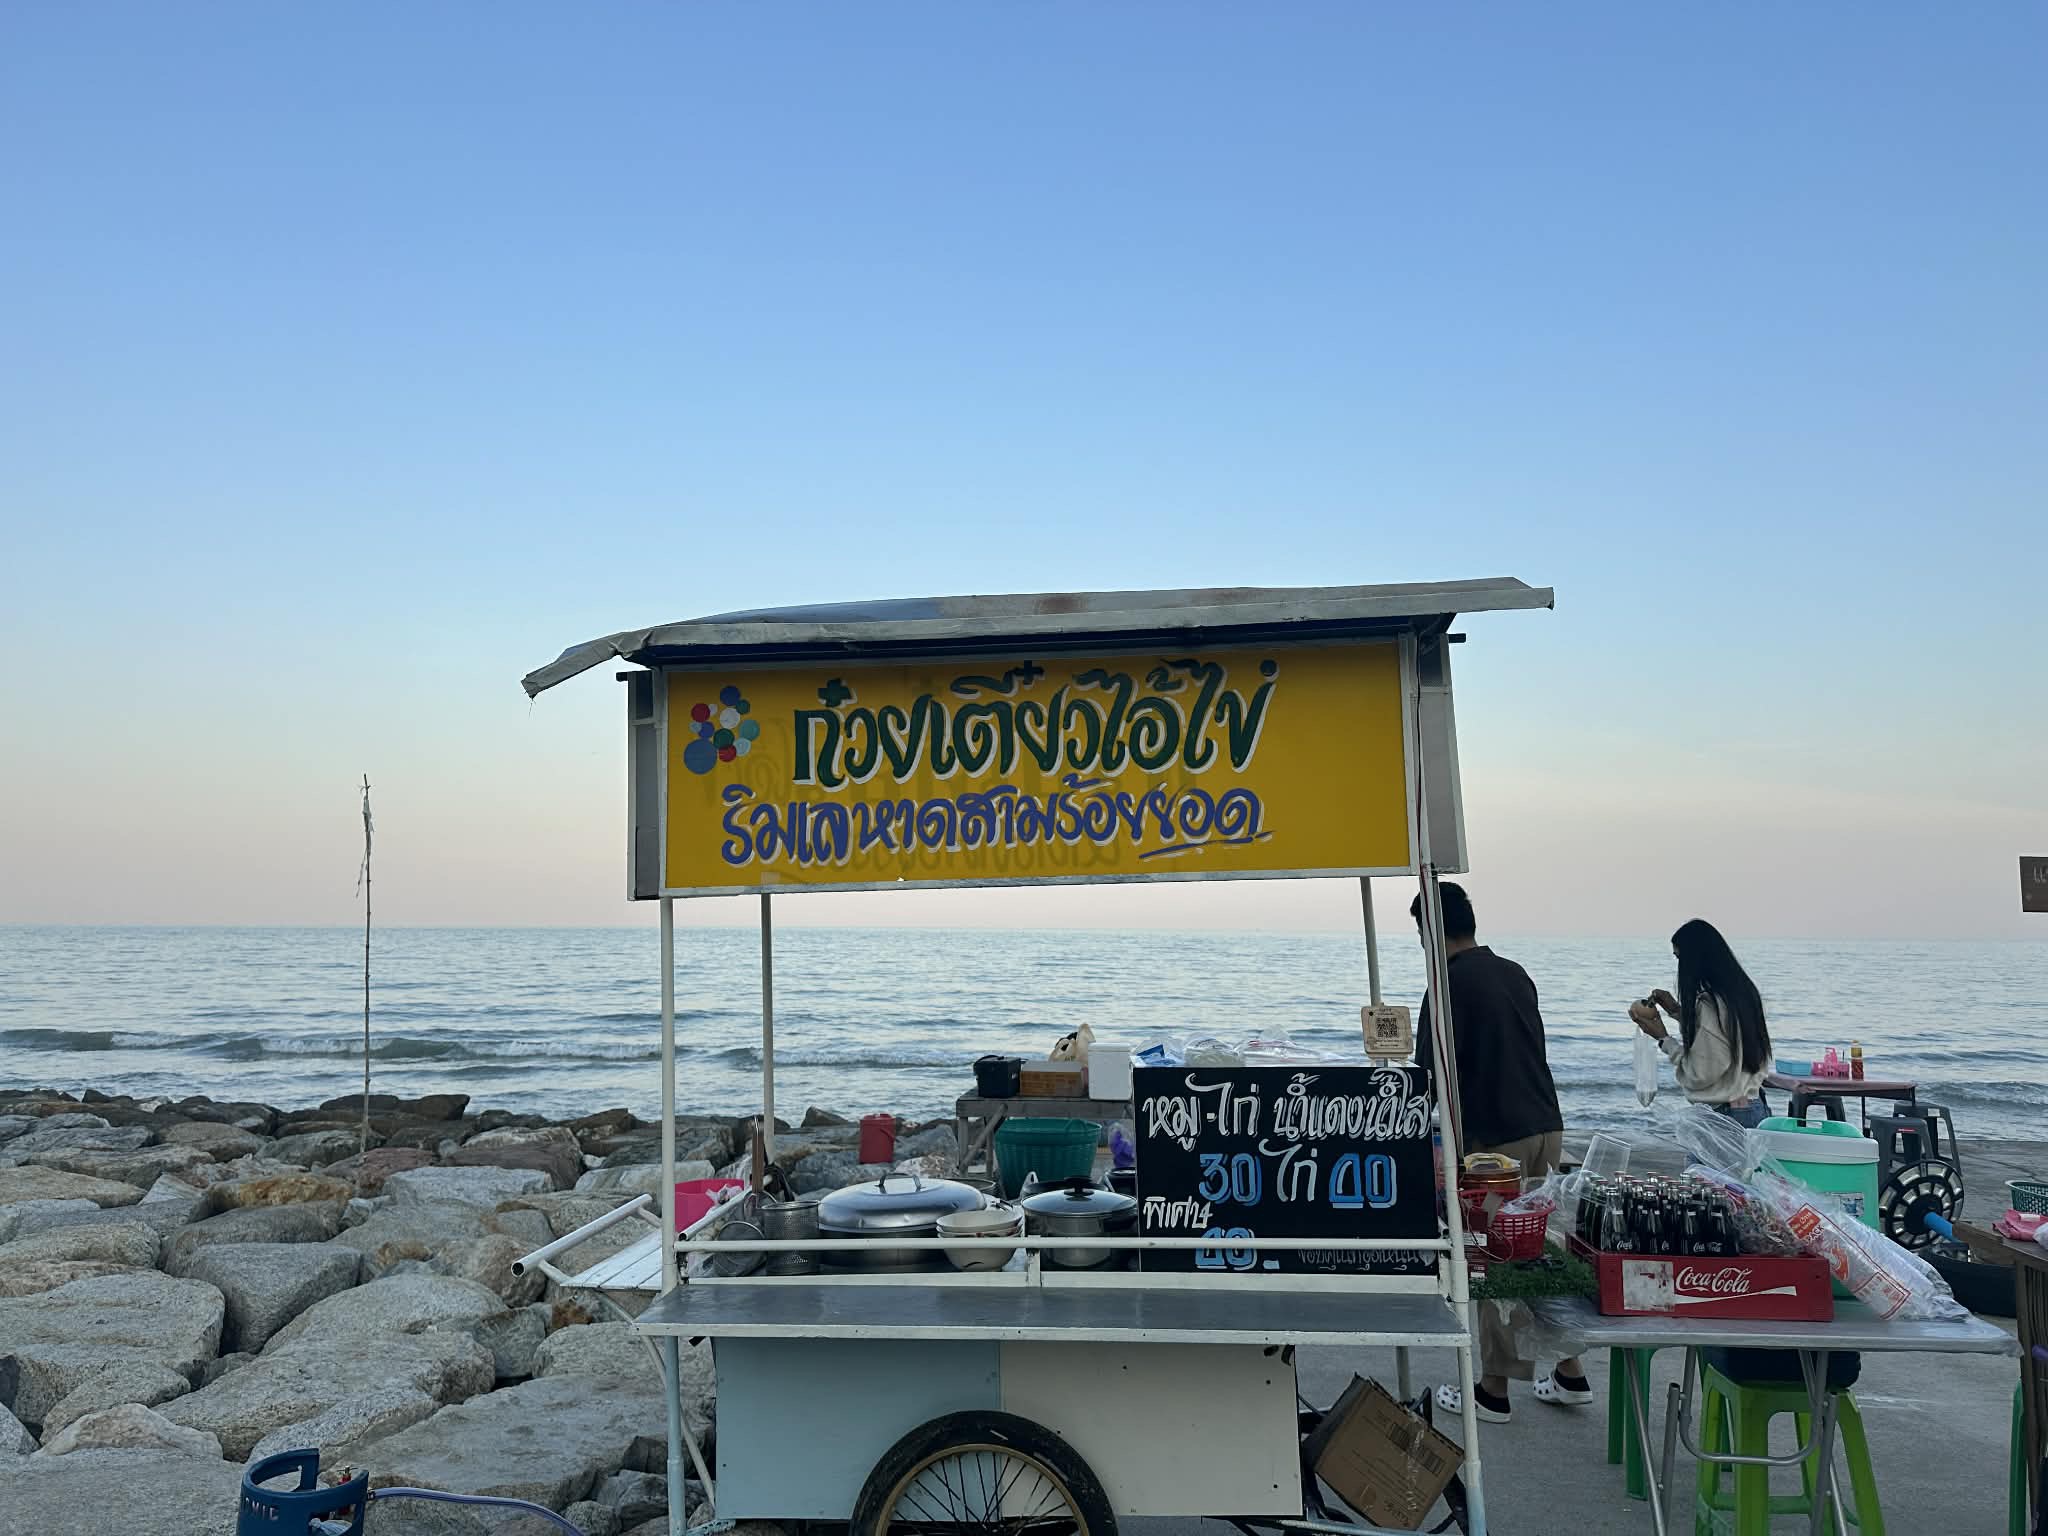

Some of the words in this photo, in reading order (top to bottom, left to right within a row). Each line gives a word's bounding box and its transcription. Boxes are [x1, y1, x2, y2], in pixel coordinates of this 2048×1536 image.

[793, 660, 1278, 792] ก๋วยเตี๋ยวไอ้ไข่
[721, 773, 1268, 866] ริมเลหาดสามร้อยยอด
[1198, 1153, 1263, 1206] 30
[1328, 1153, 1398, 1208] 40
[1142, 1195, 1213, 1229] พิเศษ
[1675, 1266, 1753, 1293] Coca-Cola
